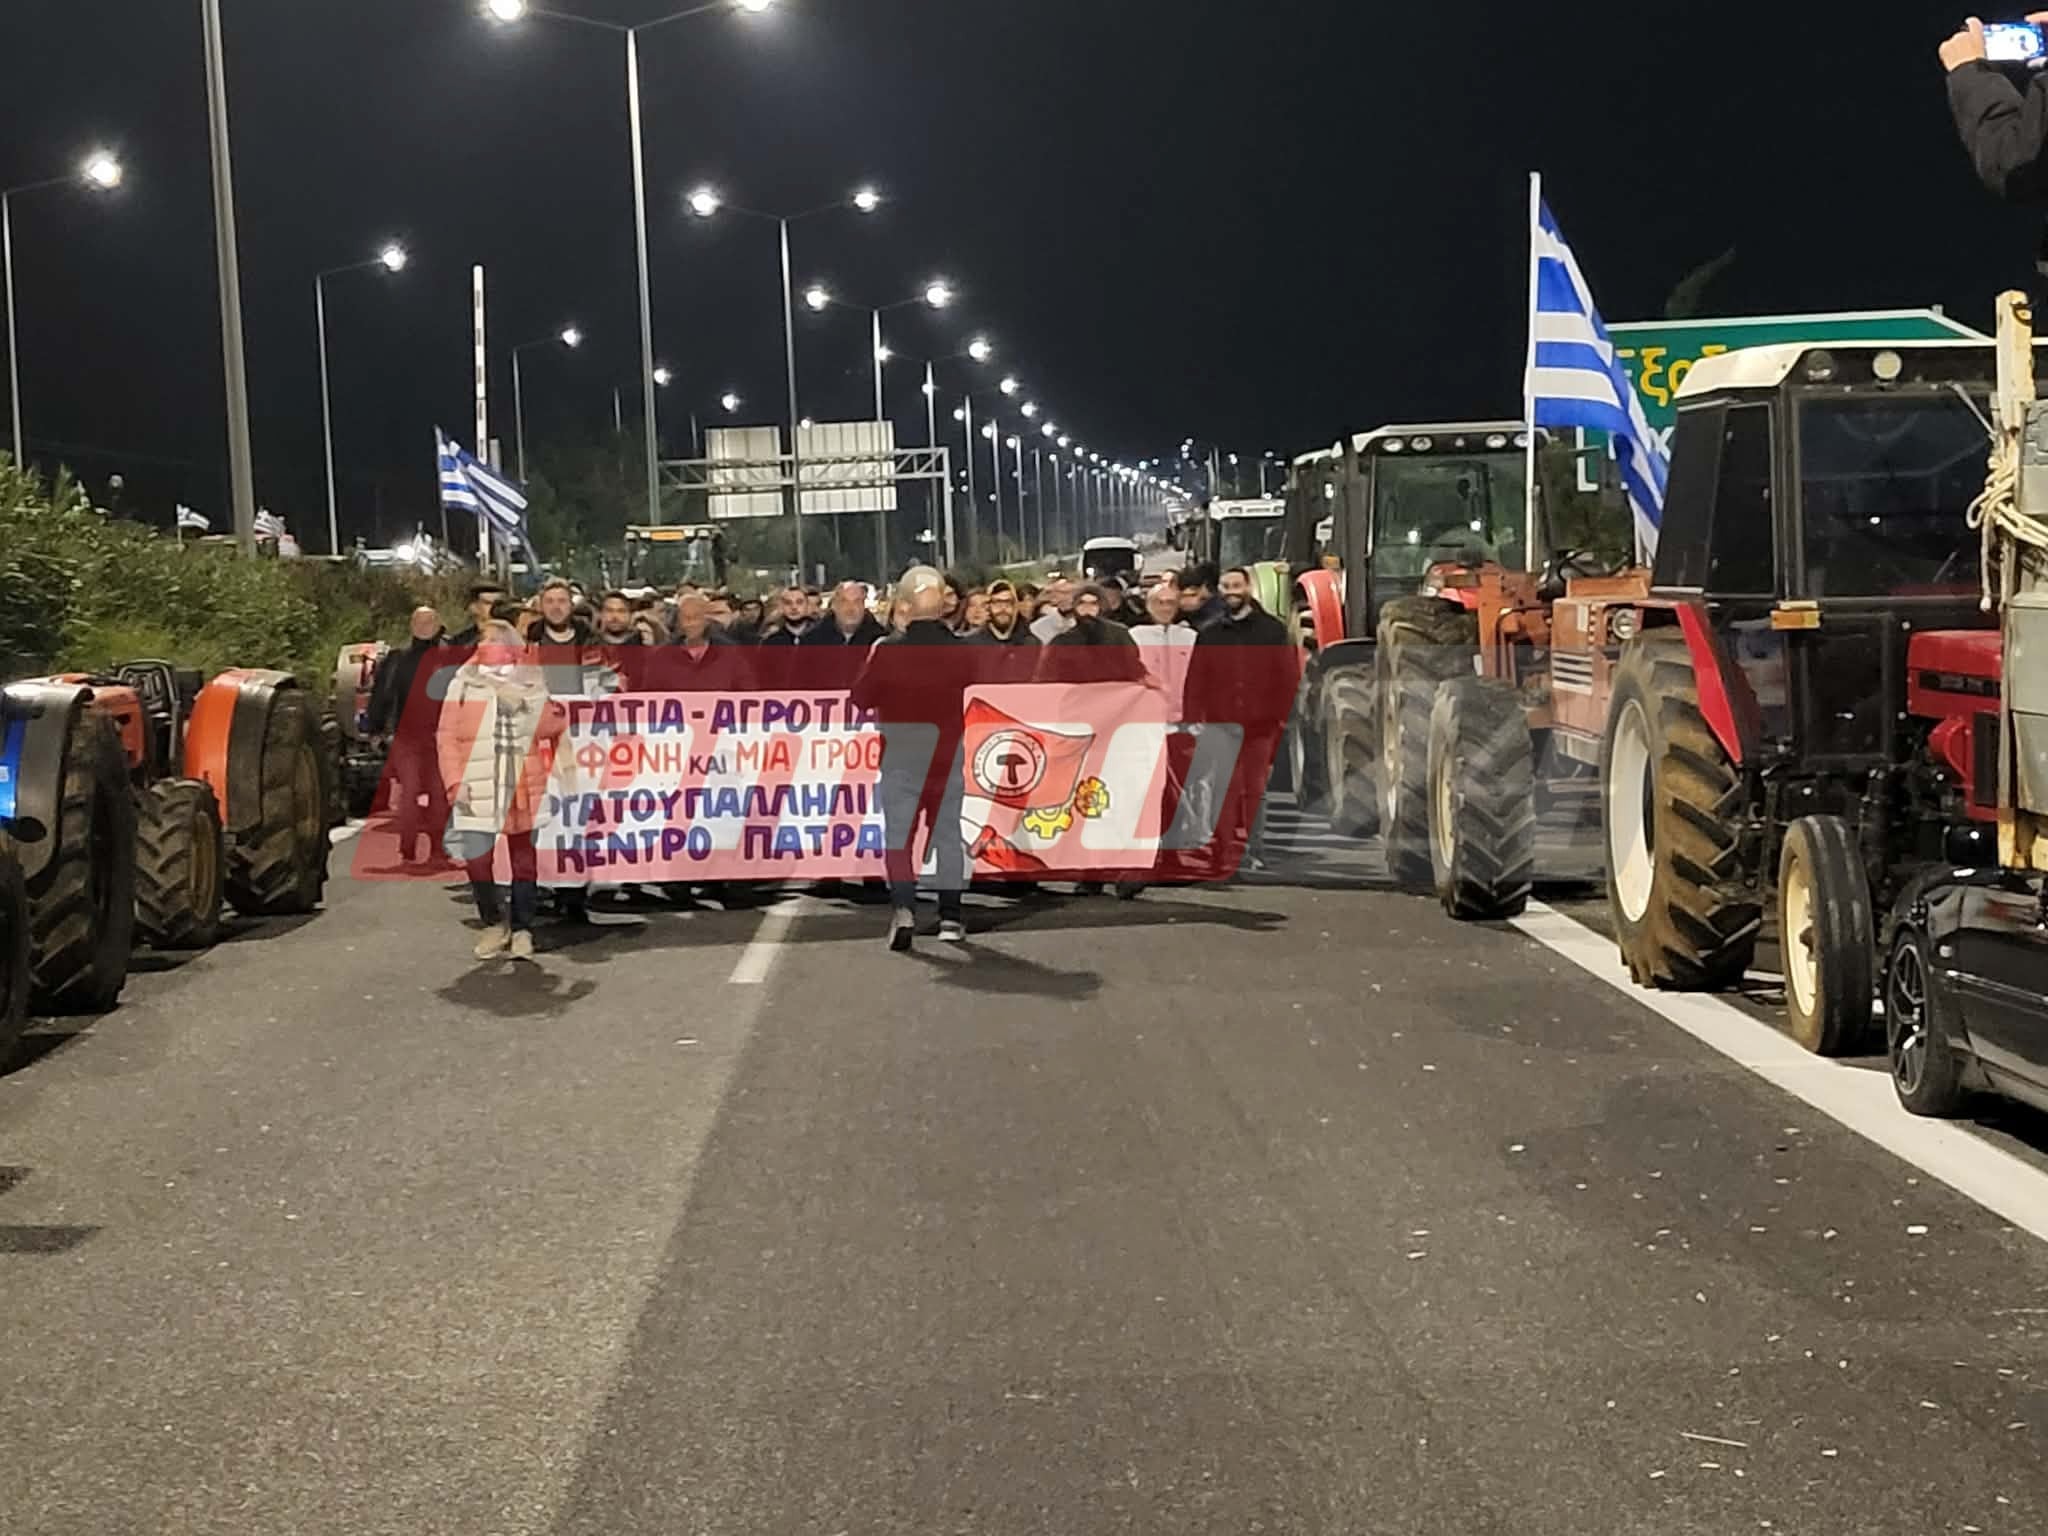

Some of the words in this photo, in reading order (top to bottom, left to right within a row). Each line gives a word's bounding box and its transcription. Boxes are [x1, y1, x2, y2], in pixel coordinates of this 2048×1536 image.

[576, 741, 682, 778] ΦΩΝΗ
[736, 740, 791, 773] ΜΙΑ
[556, 826, 712, 874] ΚΕΝΤΡΟ
[744, 823, 883, 861] ΠΑΤΡΑ
